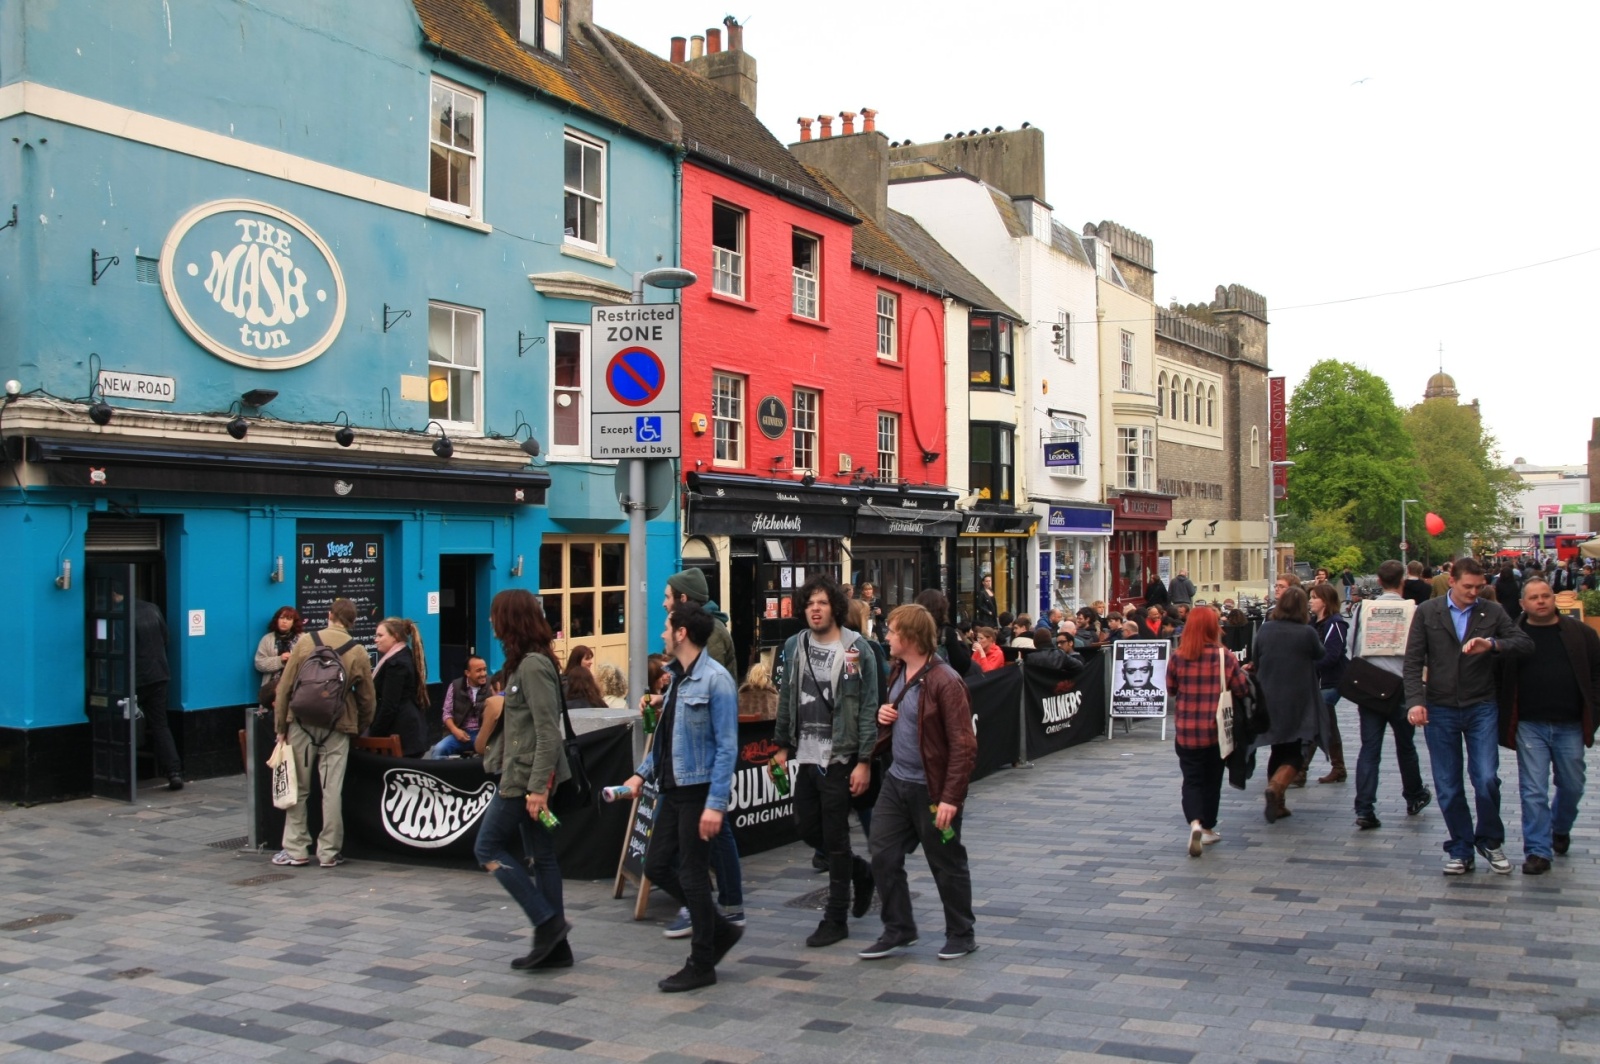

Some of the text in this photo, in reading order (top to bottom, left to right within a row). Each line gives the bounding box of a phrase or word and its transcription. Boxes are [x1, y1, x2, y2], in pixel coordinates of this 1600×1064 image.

[235, 219, 291, 255] THE
[204, 243, 309, 326] MASH
[597, 308, 674, 321] Restricted
[239, 323, 290, 350] tun
[607, 326, 663, 341] ZONE
[104, 377, 171, 396] NEW ROAD
[1272, 379, 1282, 429] PAVILION
[762, 415, 783, 427] GUINNESS
[600, 426, 633, 435] Except
[600, 444, 672, 455] in marked bays
[1048, 452, 1075, 461] Leaders
[1273, 436, 1283, 481] THEARE
[1049, 515, 1066, 525] Leaders
[1113, 689, 1165, 697] CARL CRAIG
[1042, 690, 1082, 723] BULMERS
[403, 773, 439, 791] THE
[386, 781, 463, 839] MASH
